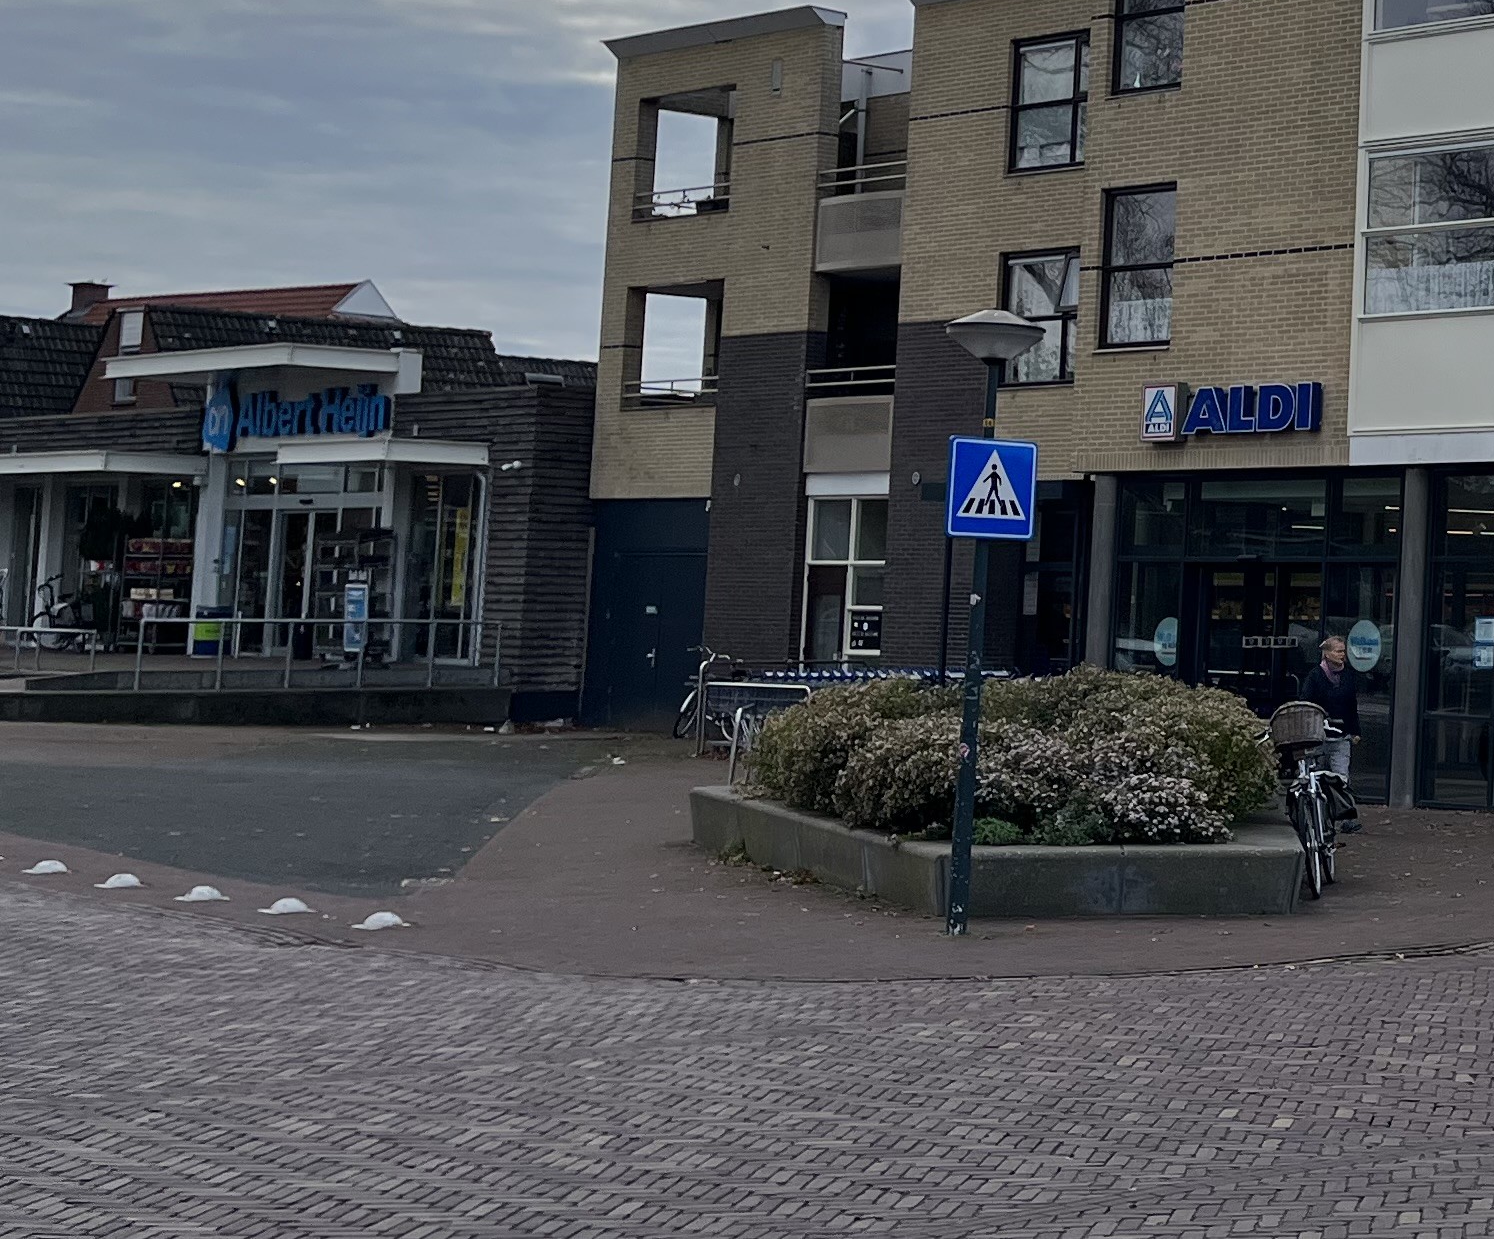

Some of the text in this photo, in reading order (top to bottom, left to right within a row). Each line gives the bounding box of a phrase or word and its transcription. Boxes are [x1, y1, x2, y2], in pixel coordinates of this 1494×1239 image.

[237, 384, 390, 438] Albert Heijn
[1147, 423, 1171, 433] ALDI
[1181, 381, 1315, 434] ALDI
